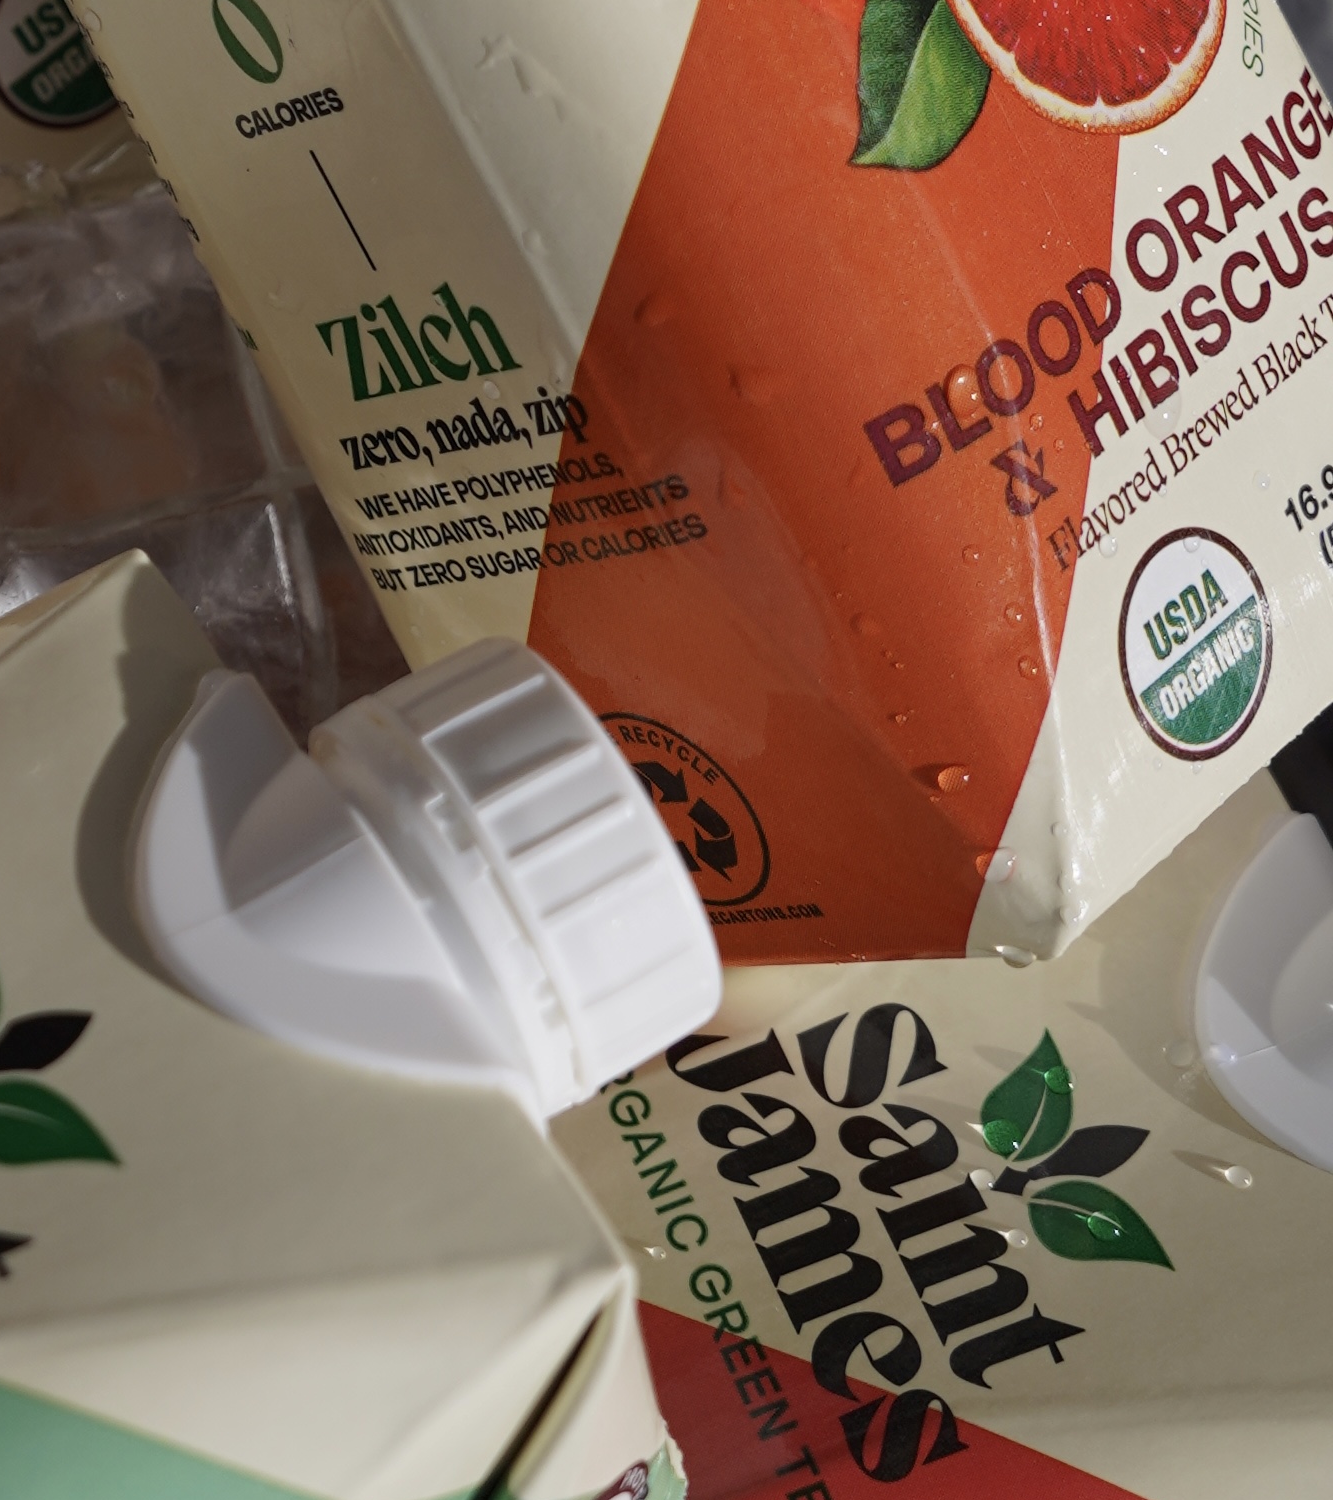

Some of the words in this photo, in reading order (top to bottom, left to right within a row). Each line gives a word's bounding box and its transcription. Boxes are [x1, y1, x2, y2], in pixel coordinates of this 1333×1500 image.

[235, 86, 344, 139] CALORIES
[862, 266, 1121, 487] BLOOD
[1126, 65, 1333, 293] ORANGE
[316, 282, 522, 401] Zilch
[991, 440, 1060, 518] &
[1068, 187, 1333, 459] HIBISCUS
[339, 409, 435, 471] zero,
[427, 397, 532, 459] nada,
[527, 386, 588, 442] zip
[1046, 449, 1167, 574] Flavored
[1160, 365, 1259, 488] Brewed
[1253, 314, 1329, 396] Black
[354, 514, 506, 556] ANTIOXIDANTS,
[505, 503, 551, 534] AND
[549, 475, 689, 526] NUTRIENTS
[356, 487, 397, 521] WE
[394, 481, 453, 514] HAVE
[454, 452, 624, 508] POLYPHENOLS,
[372, 564, 406, 592] BUT
[407, 556, 469, 586] ZERO
[469, 547, 544, 581] SUGAR
[544, 541, 582, 567] OR
[582, 514, 708, 561] CALORIES
[1143, 566, 1231, 664] USDA
[1157, 615, 1256, 722] ORGANIC
[618, 725, 719, 787] RECYCLE
[796, 1003, 1086, 1391] Saint
[599, 1075, 709, 1253] GANIC
[688, 1264, 799, 1442] GREEN
[664, 1027, 969, 1485] James
